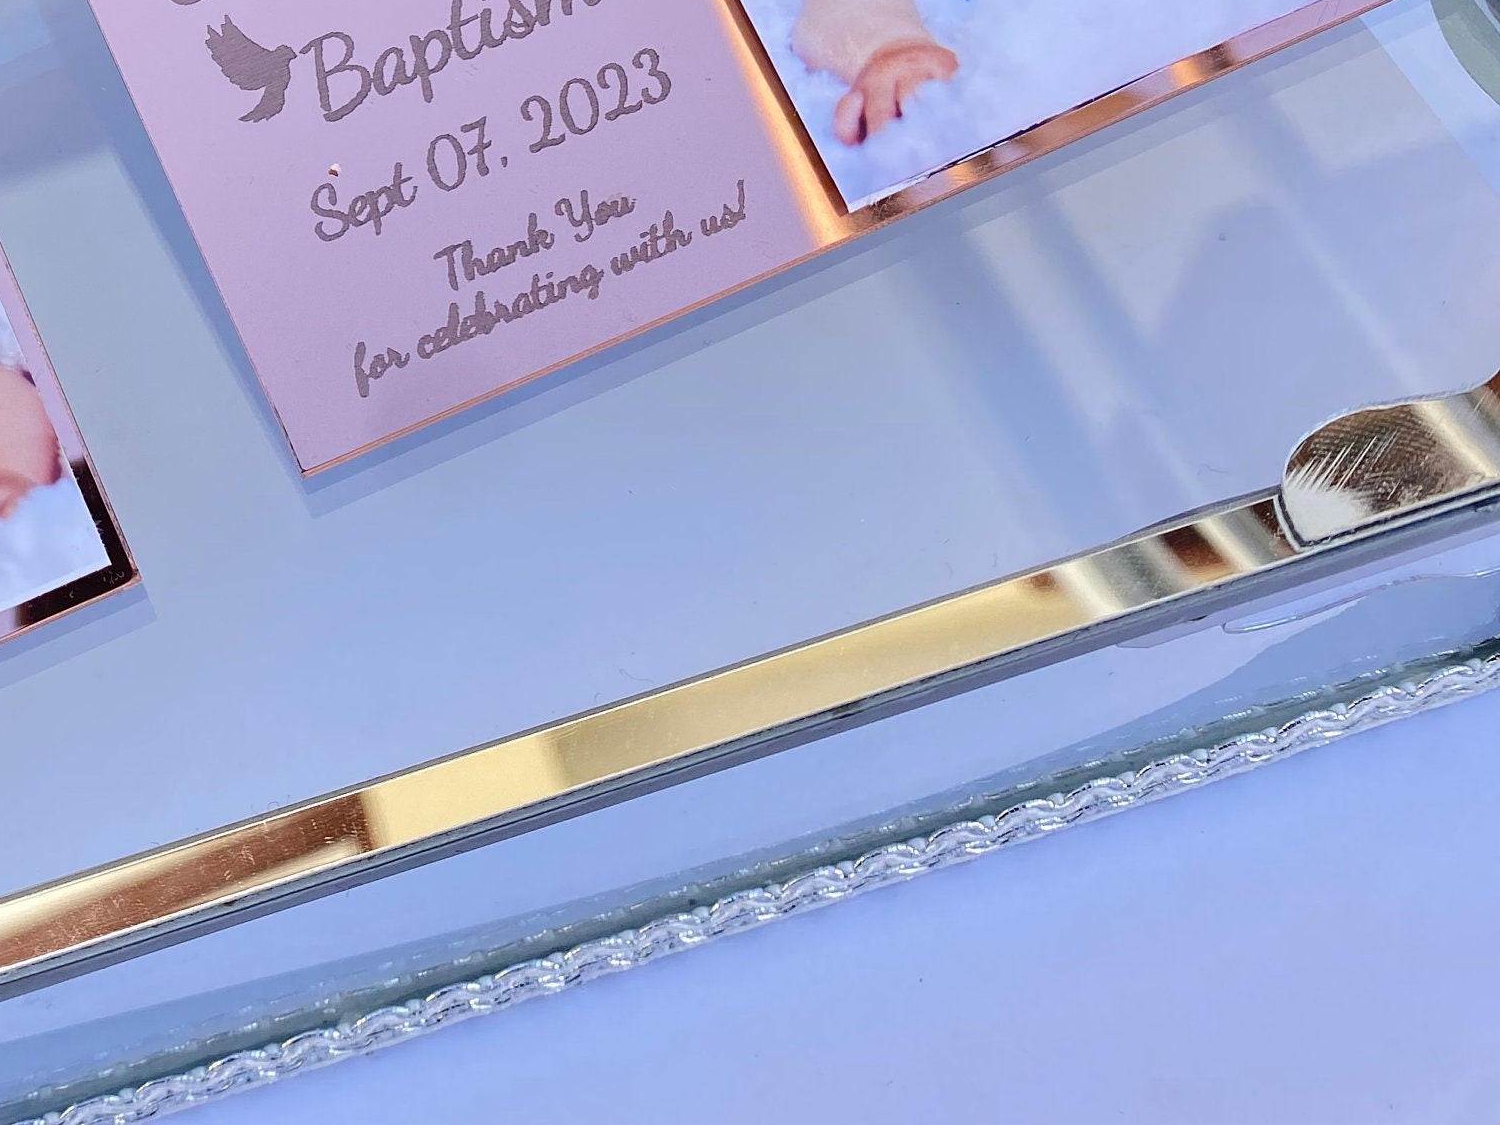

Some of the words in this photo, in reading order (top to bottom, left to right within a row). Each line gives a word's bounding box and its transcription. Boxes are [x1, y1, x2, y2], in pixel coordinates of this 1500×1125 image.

[310, 162, 418, 242] Sept
[519, 48, 672, 152] 2023
[433, 214, 555, 291] Thank
[554, 189, 636, 243] You
[354, 341, 410, 399] for
[416, 265, 605, 359] celebrating
[610, 210, 693, 276] with
[699, 179, 746, 237] us!
